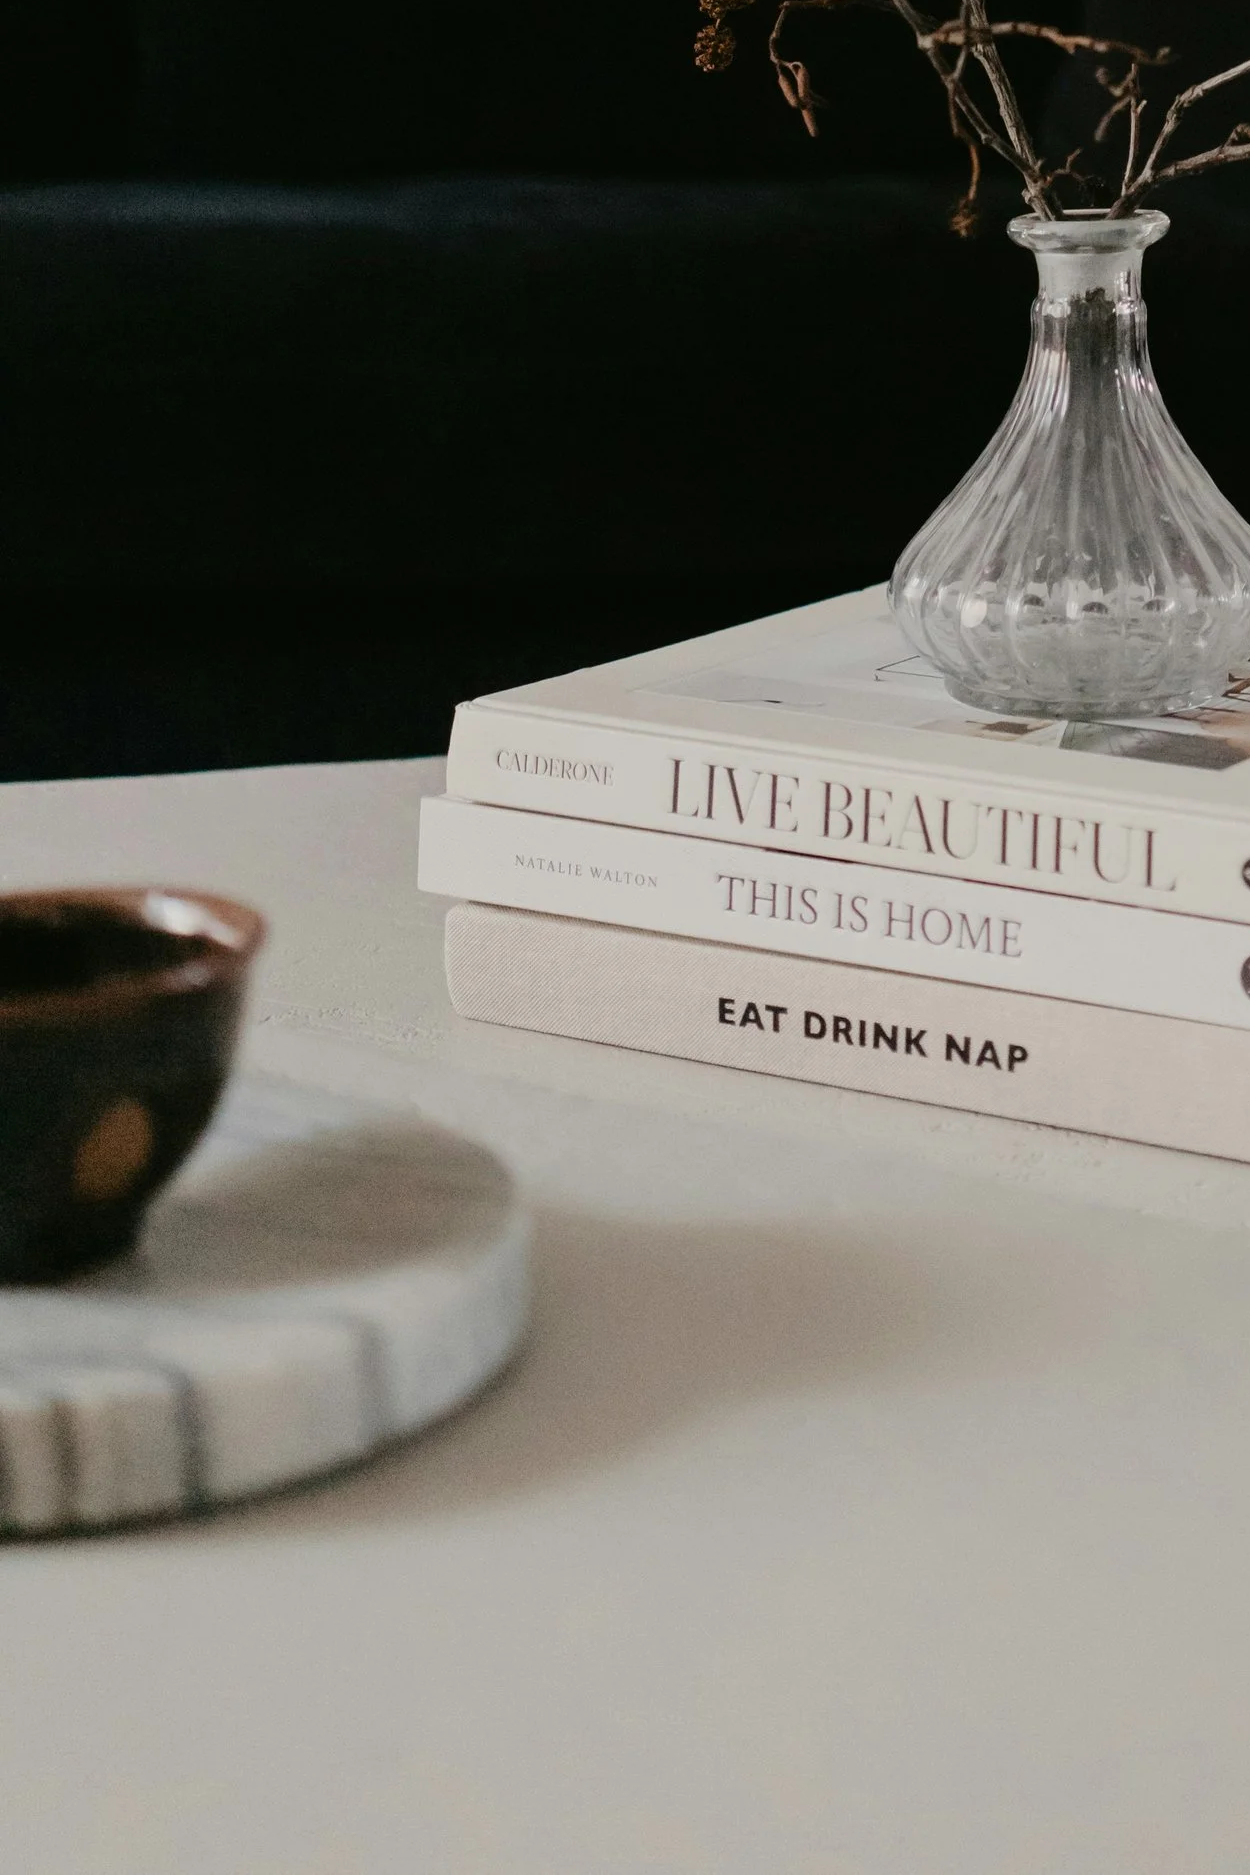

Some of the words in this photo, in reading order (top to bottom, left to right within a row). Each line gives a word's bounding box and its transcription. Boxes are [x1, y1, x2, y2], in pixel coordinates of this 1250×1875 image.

[496, 749, 614, 787] CALDERONE
[667, 757, 799, 832] LIVE
[819, 780, 1177, 892] BEAUTIFUL
[515, 855, 583, 876] NATALIE
[590, 867, 659, 888] WALTON
[716, 874, 818, 925] THIS
[831, 892, 869, 932] IS
[882, 901, 1023, 958] HOME
[718, 997, 788, 1033] EAT
[804, 1010, 928, 1058] DRINK
[945, 1033, 1028, 1072] NAP
